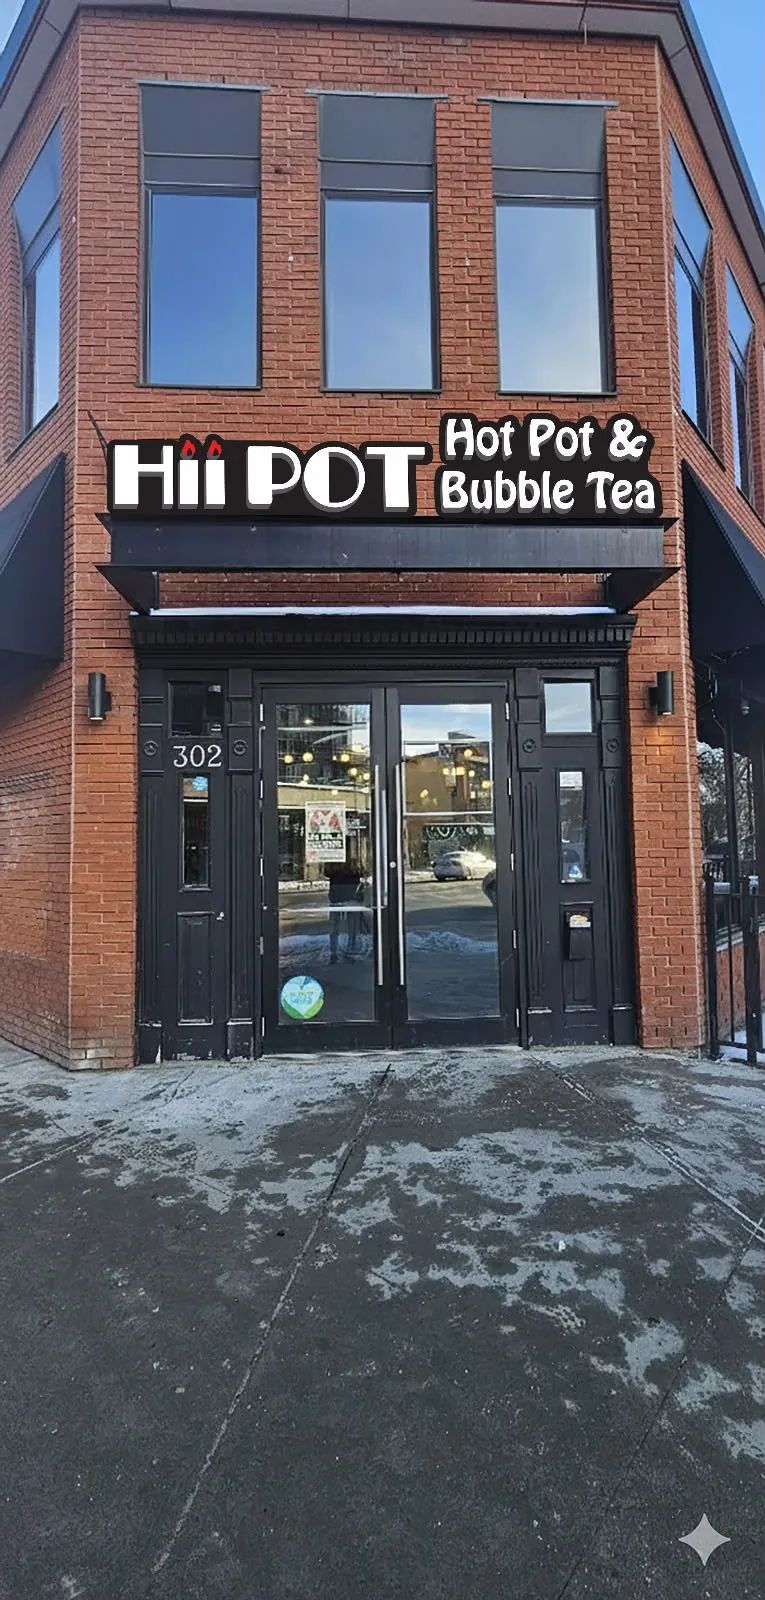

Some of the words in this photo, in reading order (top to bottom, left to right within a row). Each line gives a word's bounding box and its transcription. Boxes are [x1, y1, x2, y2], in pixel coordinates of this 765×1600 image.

[446, 418, 515, 459] Hot
[529, 418, 595, 459] Pot
[609, 418, 647, 459] &
[113, 440, 226, 507] Hii
[247, 445, 426, 509] POT
[441, 470, 575, 512] Bubble
[586, 471, 656, 512] Tea
[172, 744, 222, 768] 302
